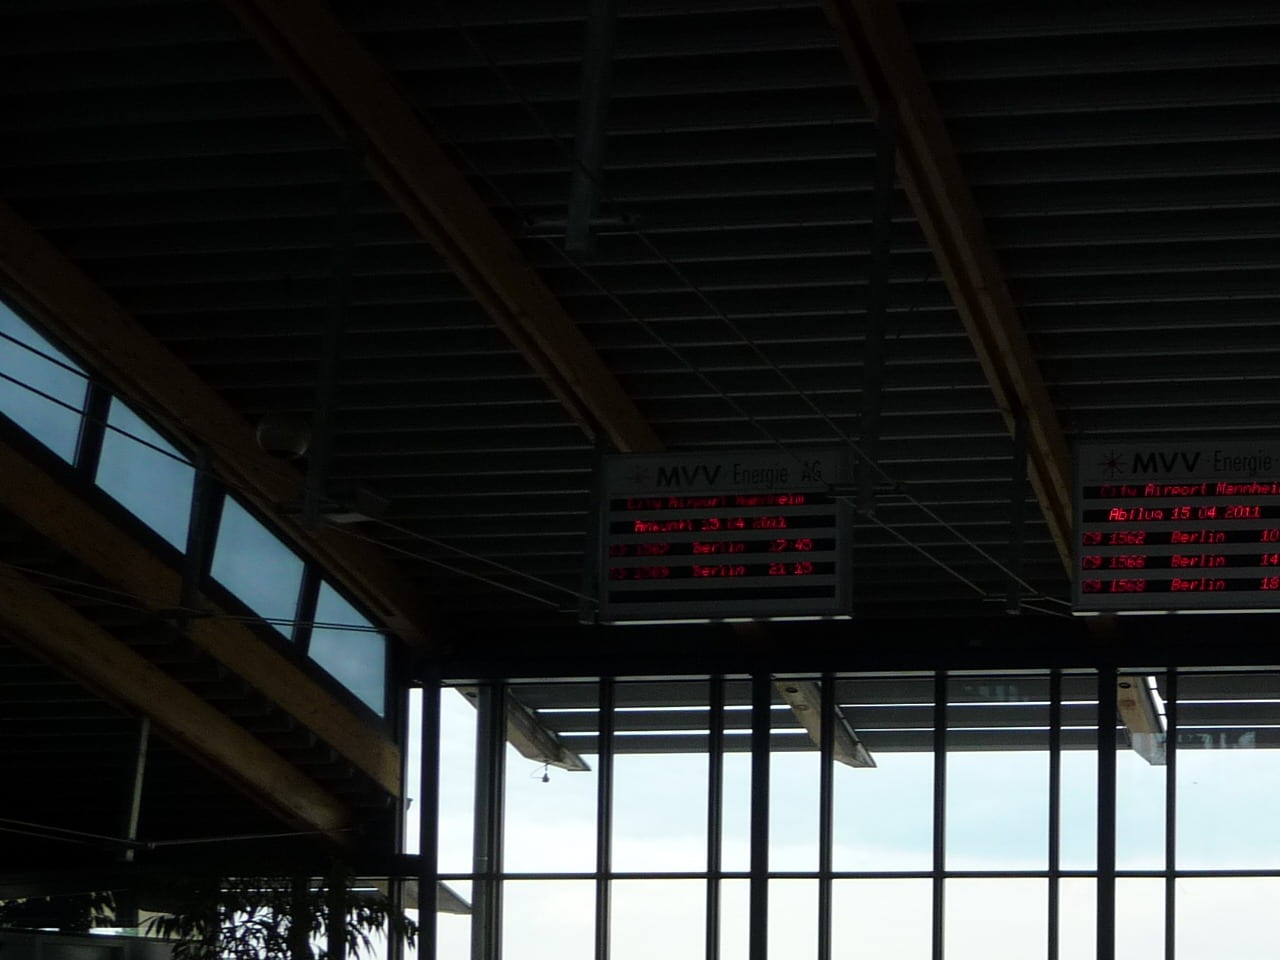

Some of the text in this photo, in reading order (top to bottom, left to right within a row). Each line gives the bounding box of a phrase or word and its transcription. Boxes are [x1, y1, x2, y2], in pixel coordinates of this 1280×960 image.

[1132, 452, 1201, 473] MVV
[1213, 449, 1273, 477] Energie
[657, 460, 822, 488] MVV Energie AG
[1144, 482, 1207, 496] Airport
[1109, 506, 1164, 521] Abflug
[1171, 529, 1226, 544] Berlin
[692, 541, 745, 554] Berlin
[1171, 553, 1226, 568] Berlin
[692, 563, 746, 577] Berlin
[1171, 577, 1226, 591] Berlin
